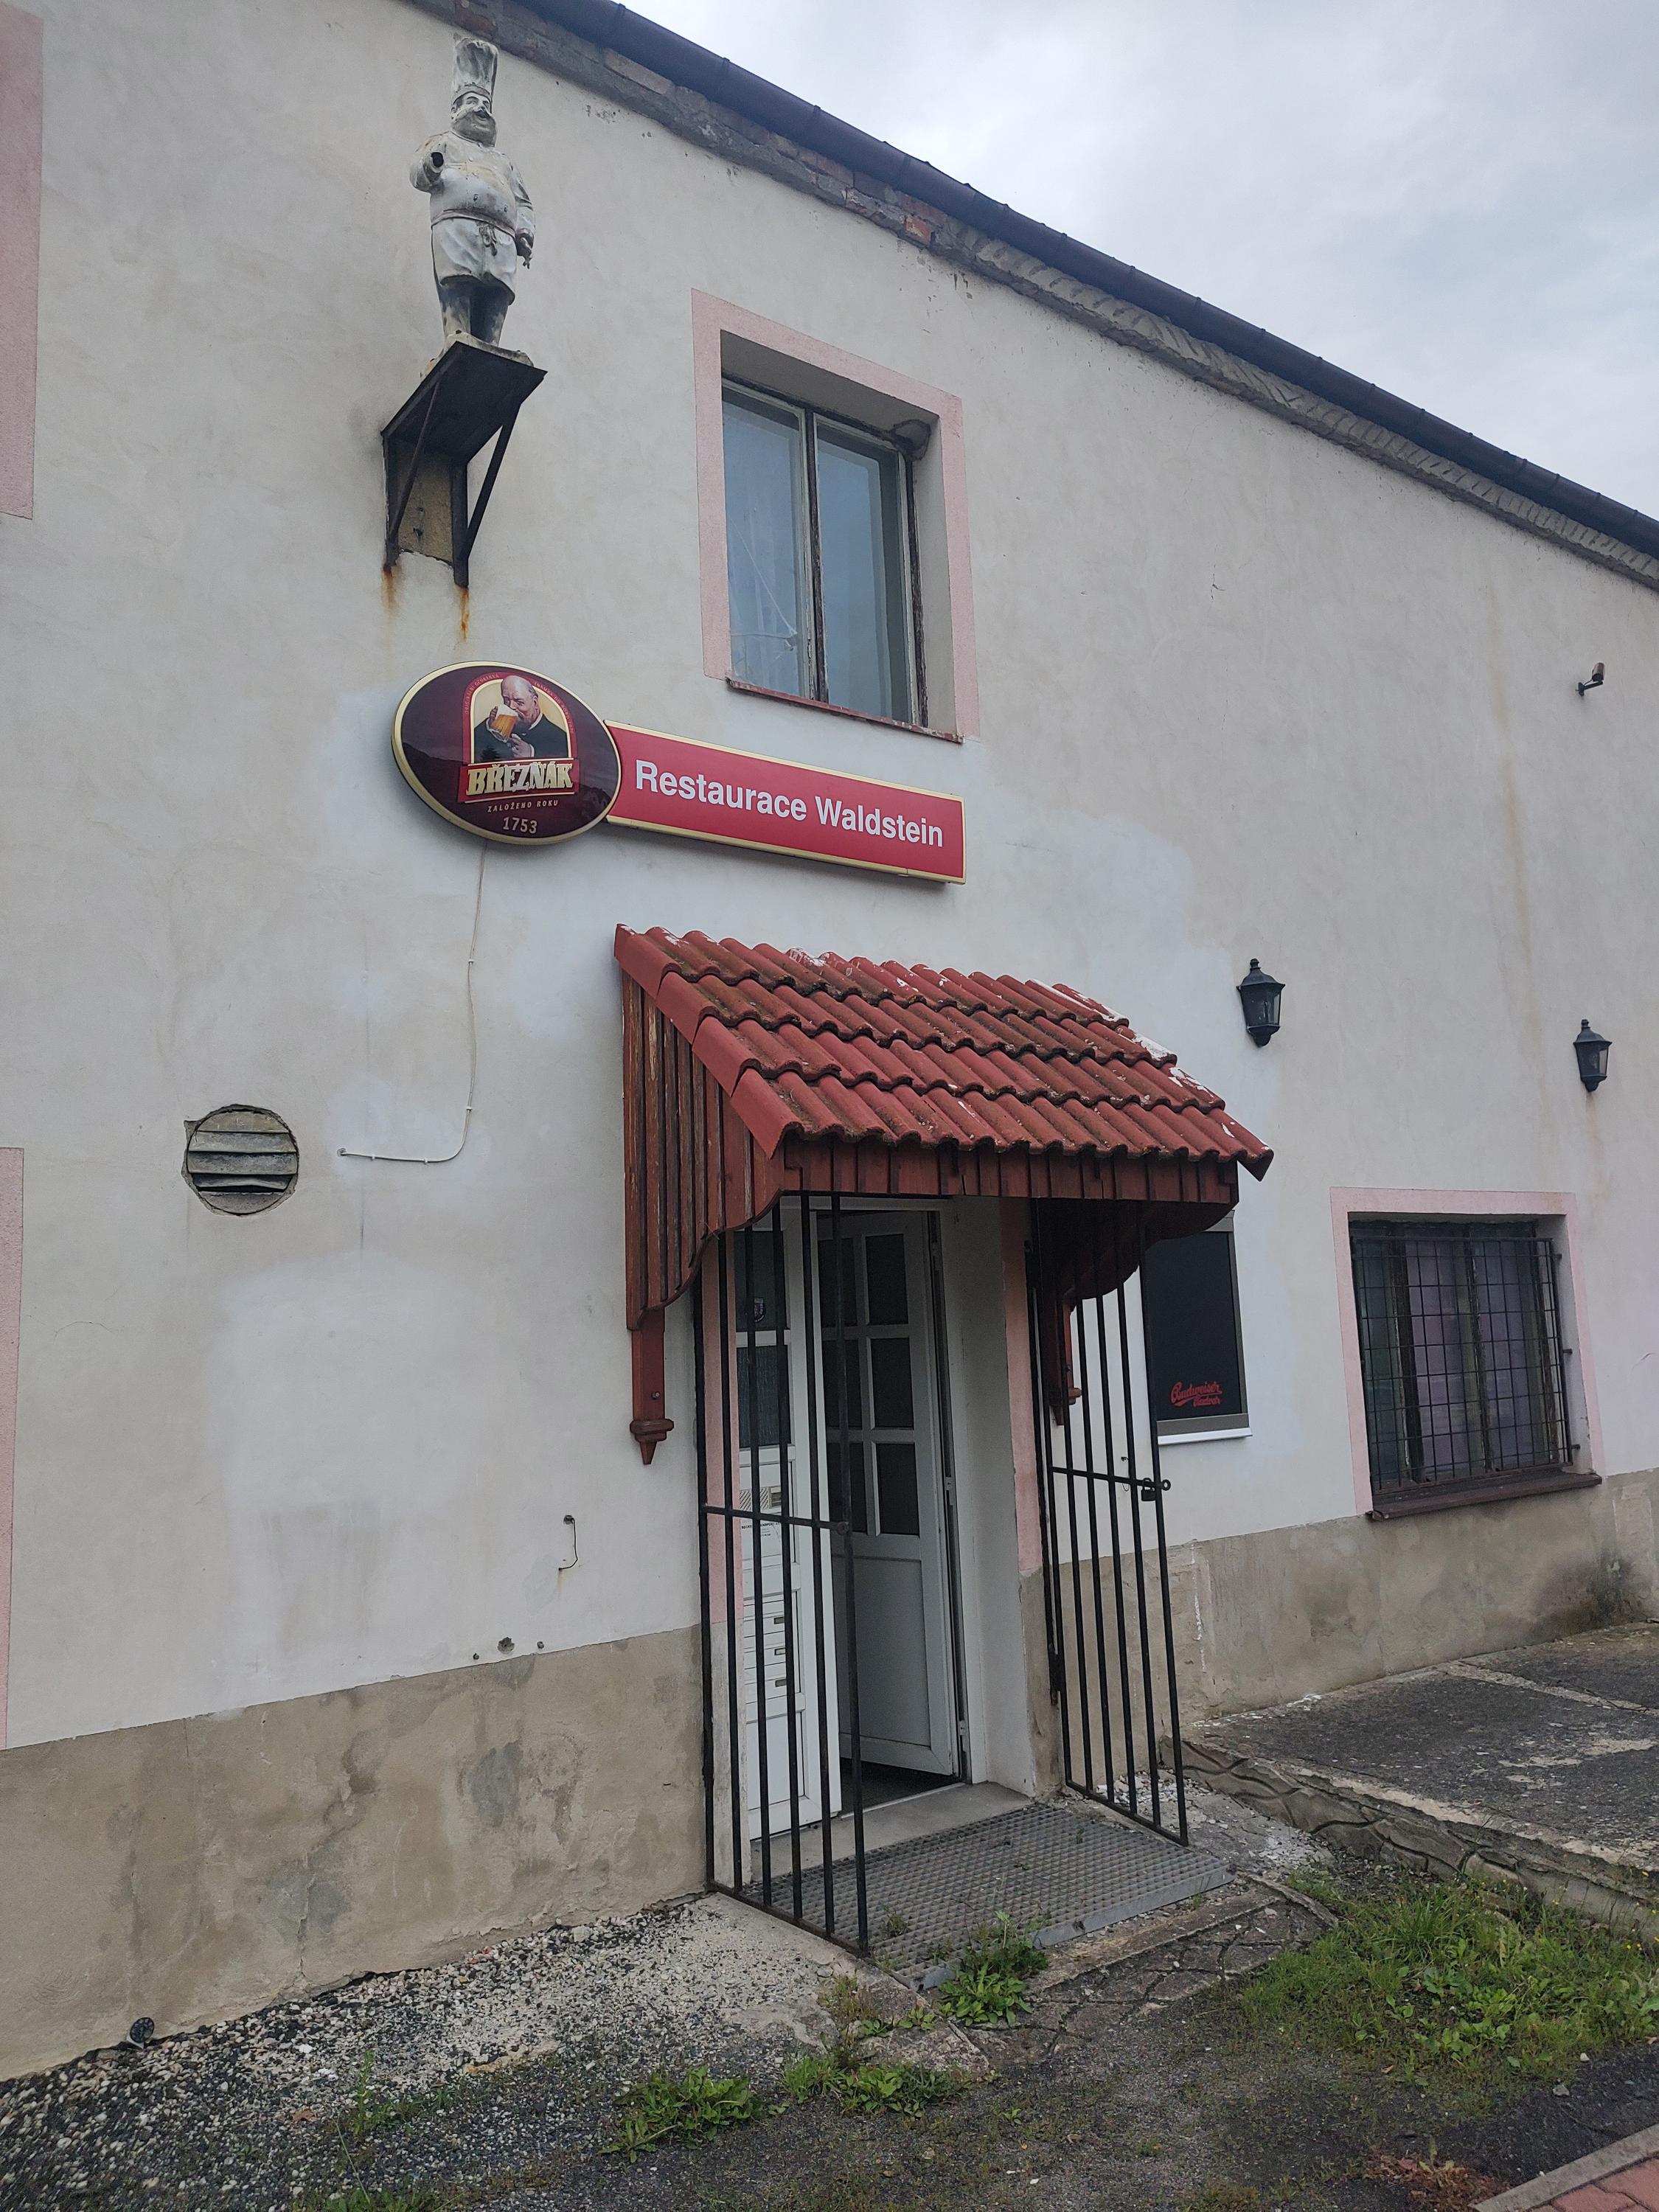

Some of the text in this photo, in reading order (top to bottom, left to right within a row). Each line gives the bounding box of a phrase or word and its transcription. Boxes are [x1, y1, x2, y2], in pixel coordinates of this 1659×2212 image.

[466, 761, 574, 796] BŘEZŇÁK
[487, 799, 558, 813] ZALOŽENO ROKU
[636, 759, 943, 847] Restaurace Waldstein
[503, 816, 538, 834] 1753
[1171, 1381, 1223, 1407] Budweiser
